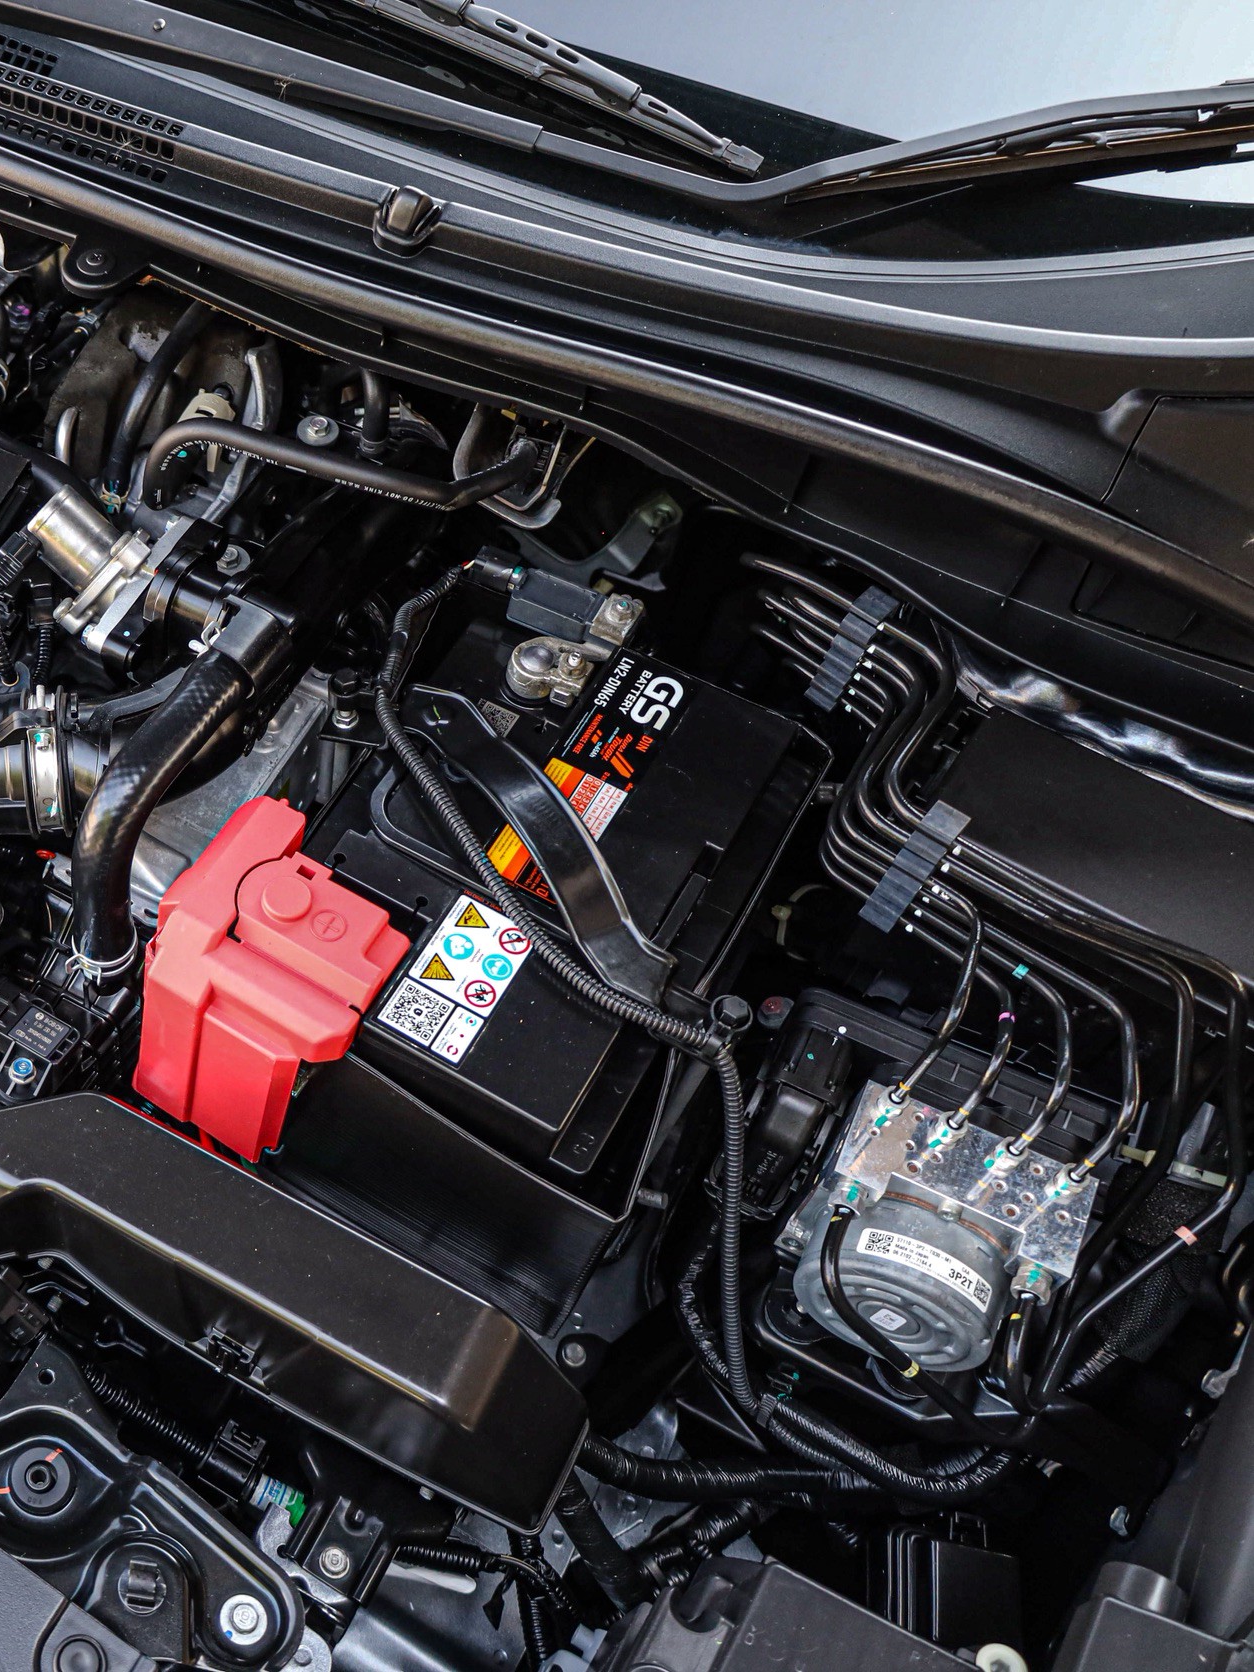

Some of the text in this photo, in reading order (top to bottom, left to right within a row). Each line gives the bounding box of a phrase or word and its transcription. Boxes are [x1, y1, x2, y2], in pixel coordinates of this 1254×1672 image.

[593, 656, 634, 708] LN2-DIN65
[618, 669, 653, 715] BATTERY
[629, 676, 684, 731] GS
[579, 712, 603, 743] MAINTENANCE
[571, 741, 583, 754] FREE
[634, 734, 653, 753] DIN
[43, 1017, 64, 1032] BOSCH
[948, 1268, 973, 1289] 3P2T
